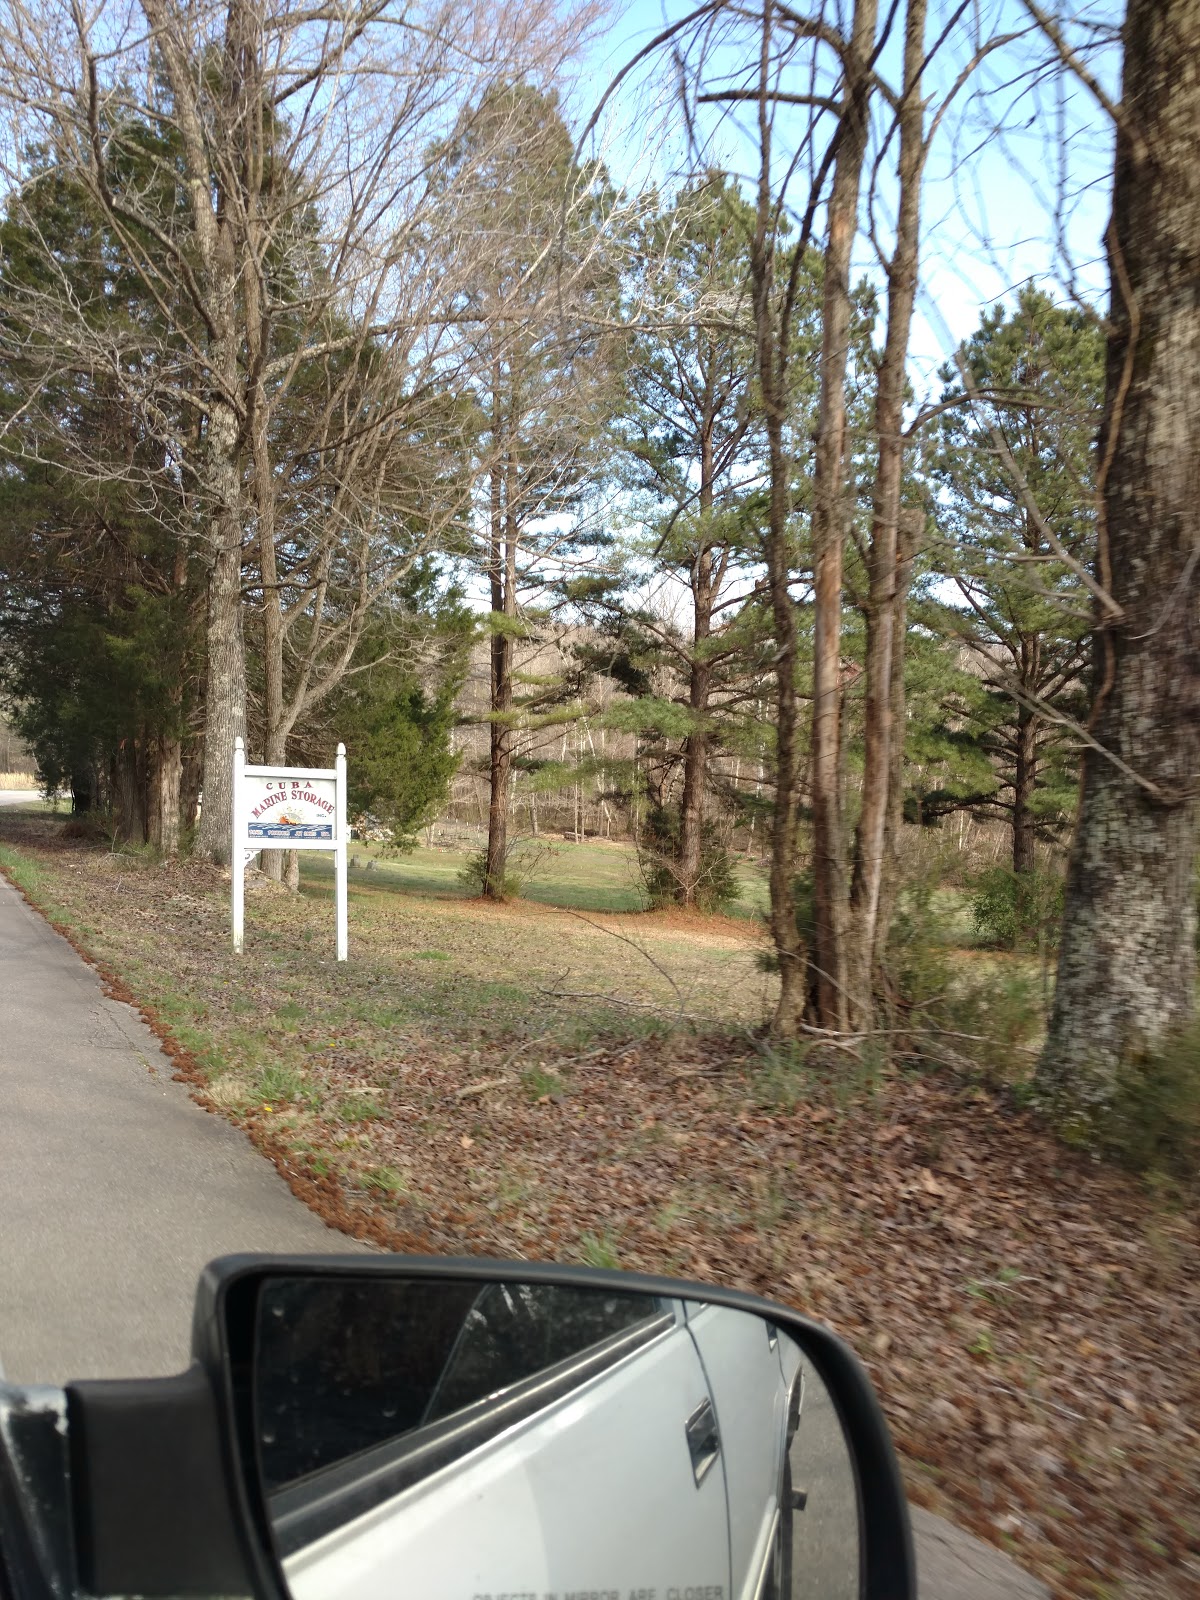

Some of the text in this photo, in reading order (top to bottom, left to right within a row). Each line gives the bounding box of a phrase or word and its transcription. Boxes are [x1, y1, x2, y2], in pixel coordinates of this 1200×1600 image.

[265, 781, 313, 790] CUBA
[251, 790, 335, 819] MARINE STORAGE
[629, 1588, 656, 1600] ARE
[667, 1586, 723, 1600] CLOSER
